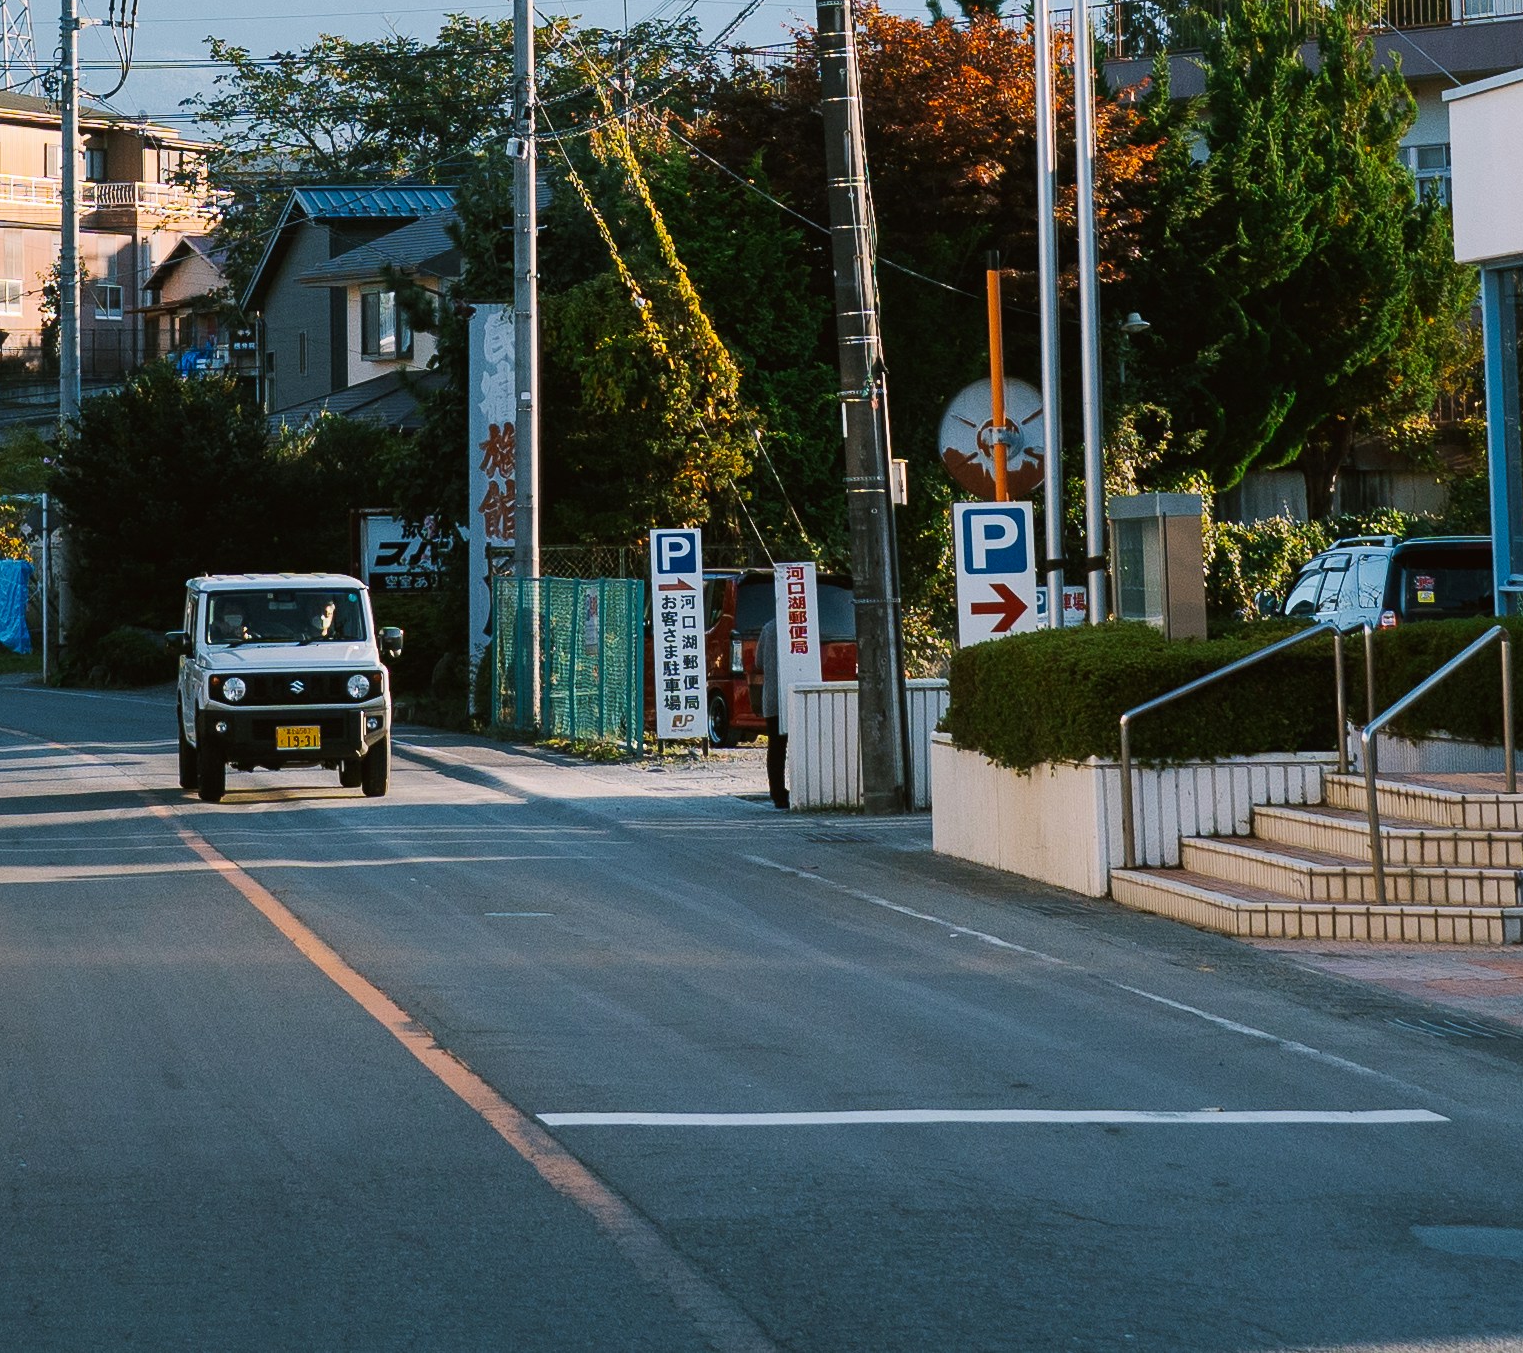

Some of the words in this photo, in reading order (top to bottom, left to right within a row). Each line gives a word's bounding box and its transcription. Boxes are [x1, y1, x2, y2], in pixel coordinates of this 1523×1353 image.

[661, 537, 690, 570] P
[970, 514, 1019, 569] P
[786, 566, 809, 654] 河口湖郵便局
[1064, 592, 1085, 611] 車場
[661, 595, 682, 711] お客さま駐車場
[680, 595, 700, 710] 河口湖郵便局
[287, 735, 317, 748] 19-31
